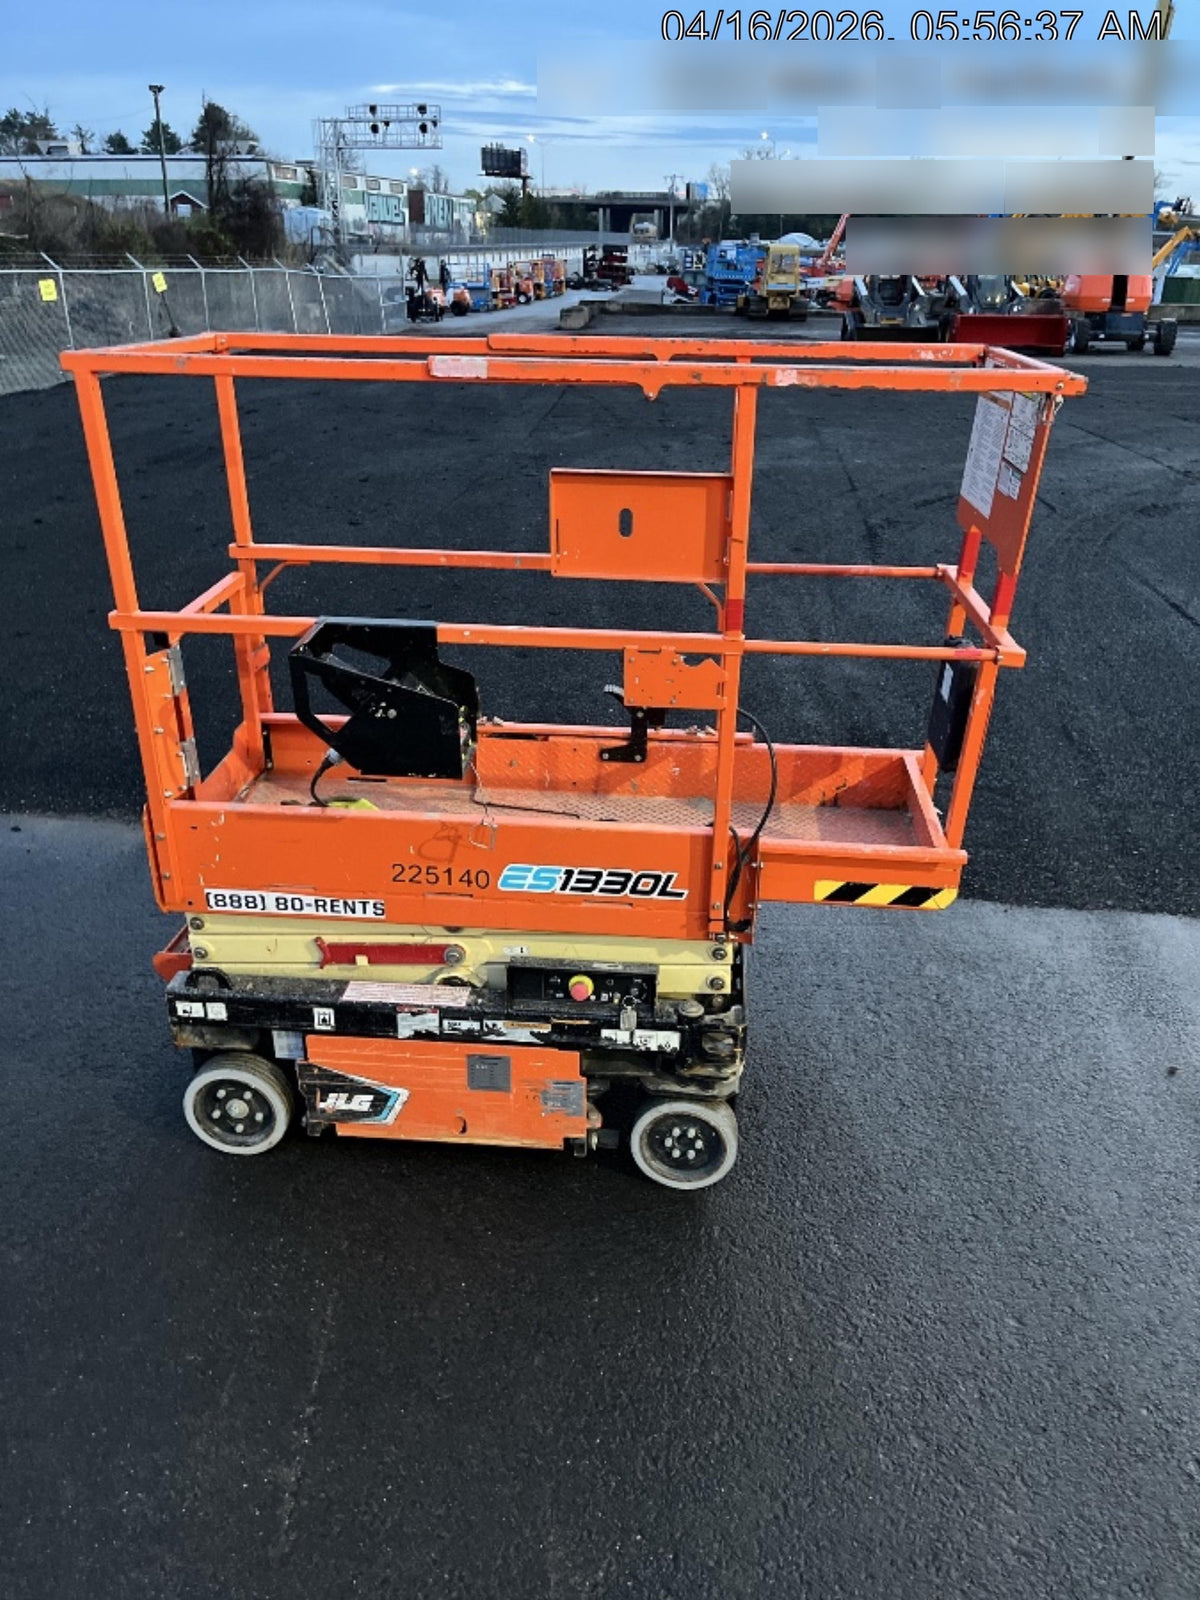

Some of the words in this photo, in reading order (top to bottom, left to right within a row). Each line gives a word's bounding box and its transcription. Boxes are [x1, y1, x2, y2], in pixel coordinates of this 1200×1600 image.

[392, 863, 490, 889] 225140
[499, 865, 686, 899] ES1330L
[205, 892, 266, 911] (888)
[275, 897, 385, 916] 80-RENTS
[319, 1092, 375, 1112] JLG
